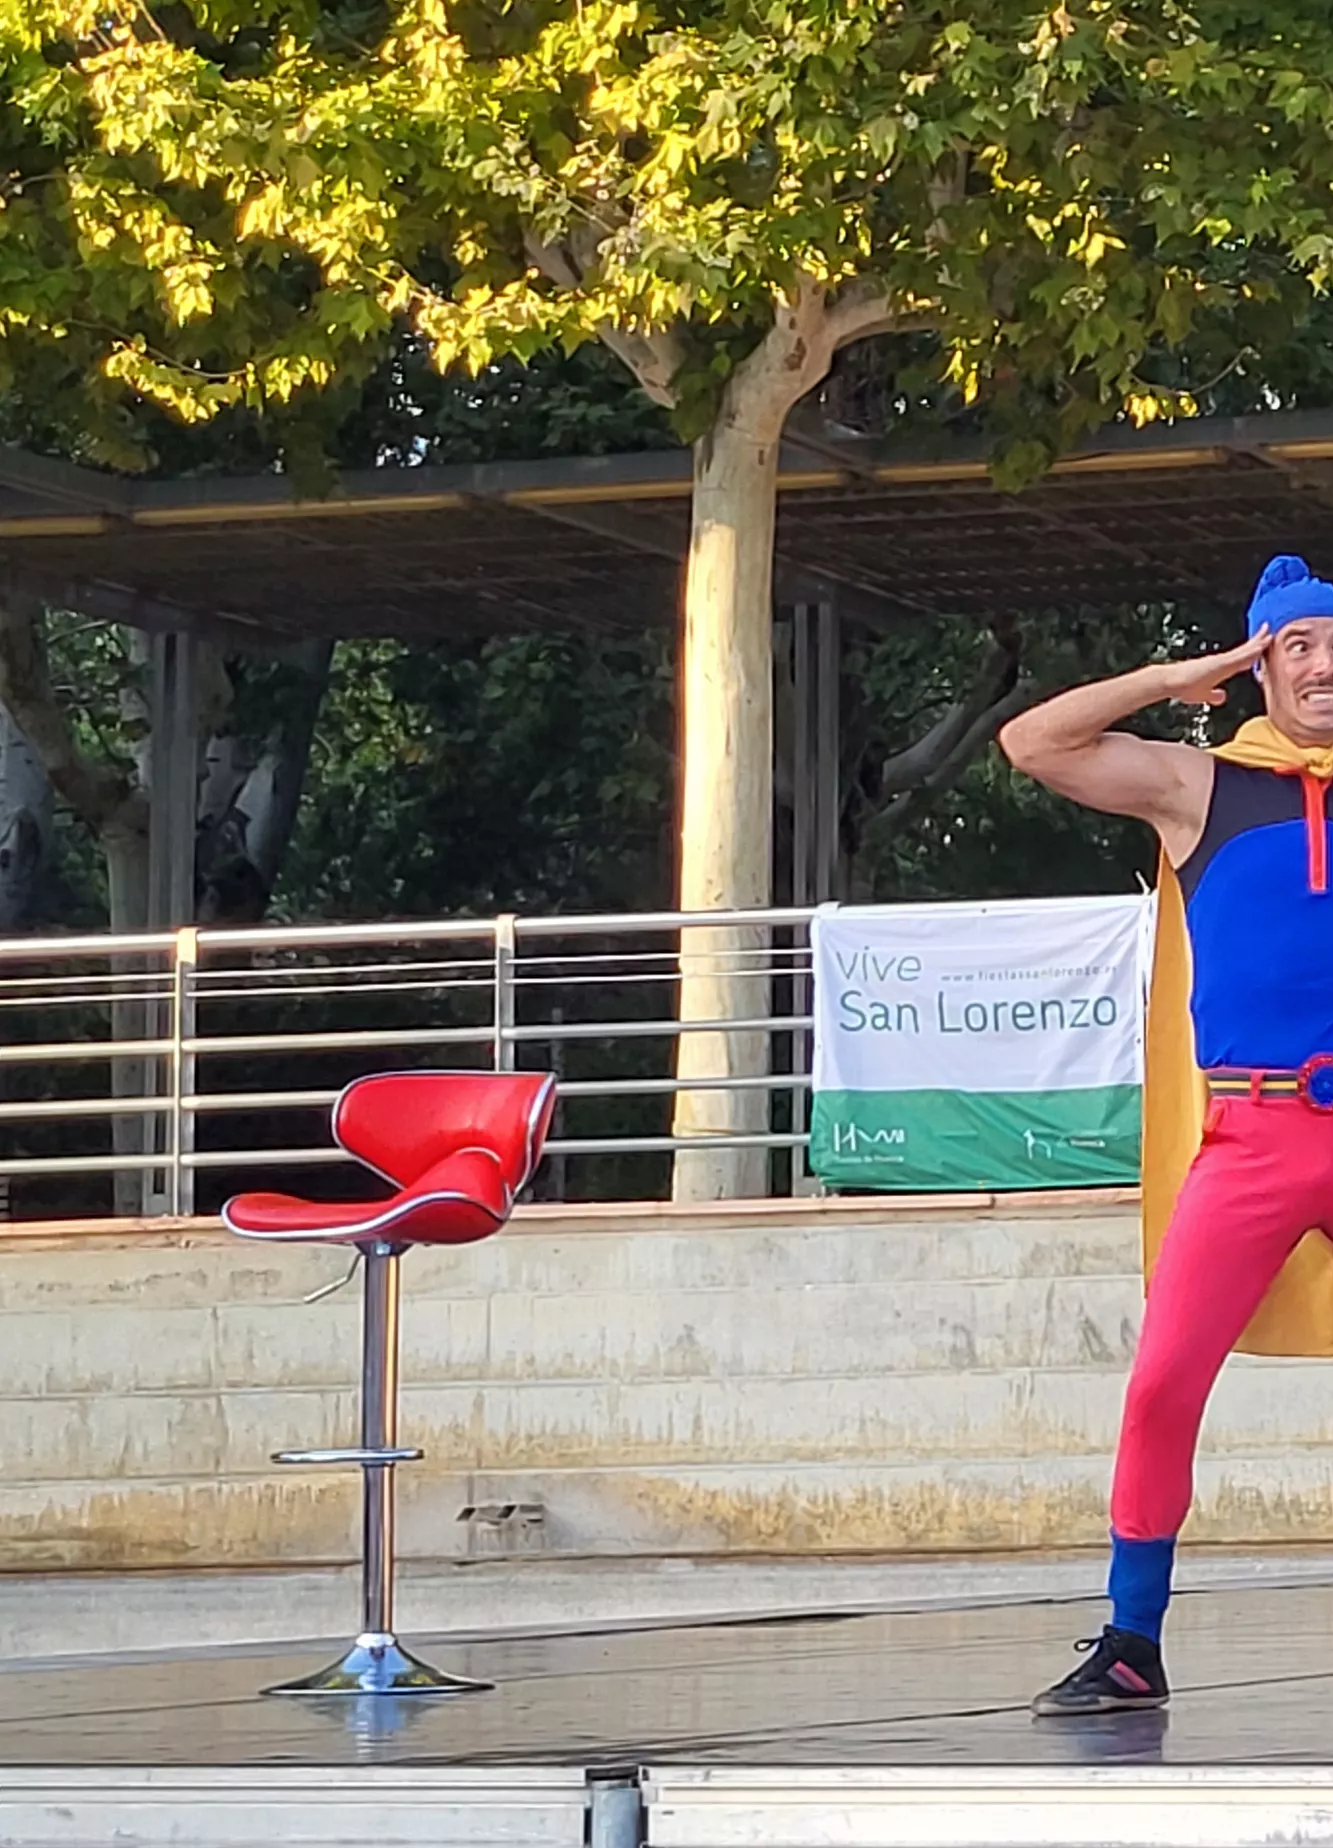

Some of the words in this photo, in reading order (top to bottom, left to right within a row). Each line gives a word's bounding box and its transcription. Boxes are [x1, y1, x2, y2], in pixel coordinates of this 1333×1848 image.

[836, 946, 922, 982] vive
[839, 990, 920, 1033] San
[937, 991, 1117, 1033] Lorenzo
